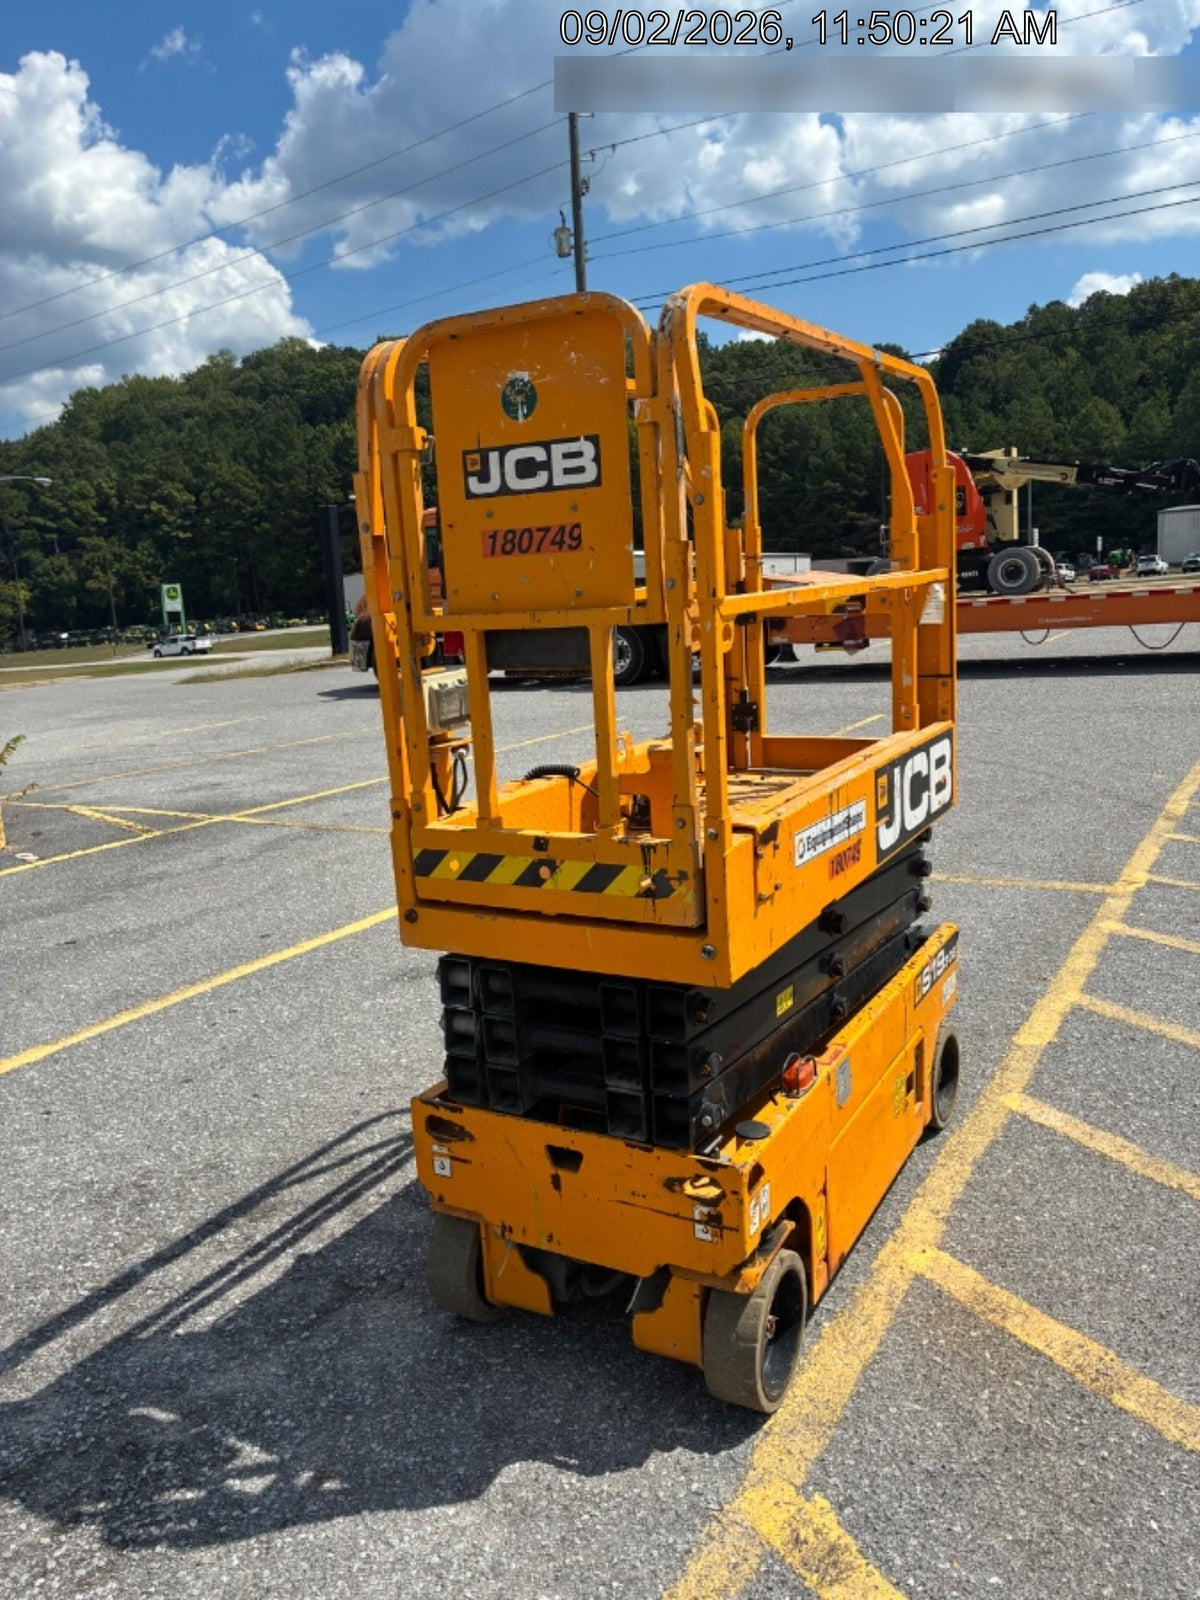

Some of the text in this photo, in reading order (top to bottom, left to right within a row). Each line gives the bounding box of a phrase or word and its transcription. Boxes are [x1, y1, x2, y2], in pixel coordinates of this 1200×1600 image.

[467, 440, 599, 495] JCB
[487, 522, 582, 556] 180749
[877, 737, 953, 851] JCB
